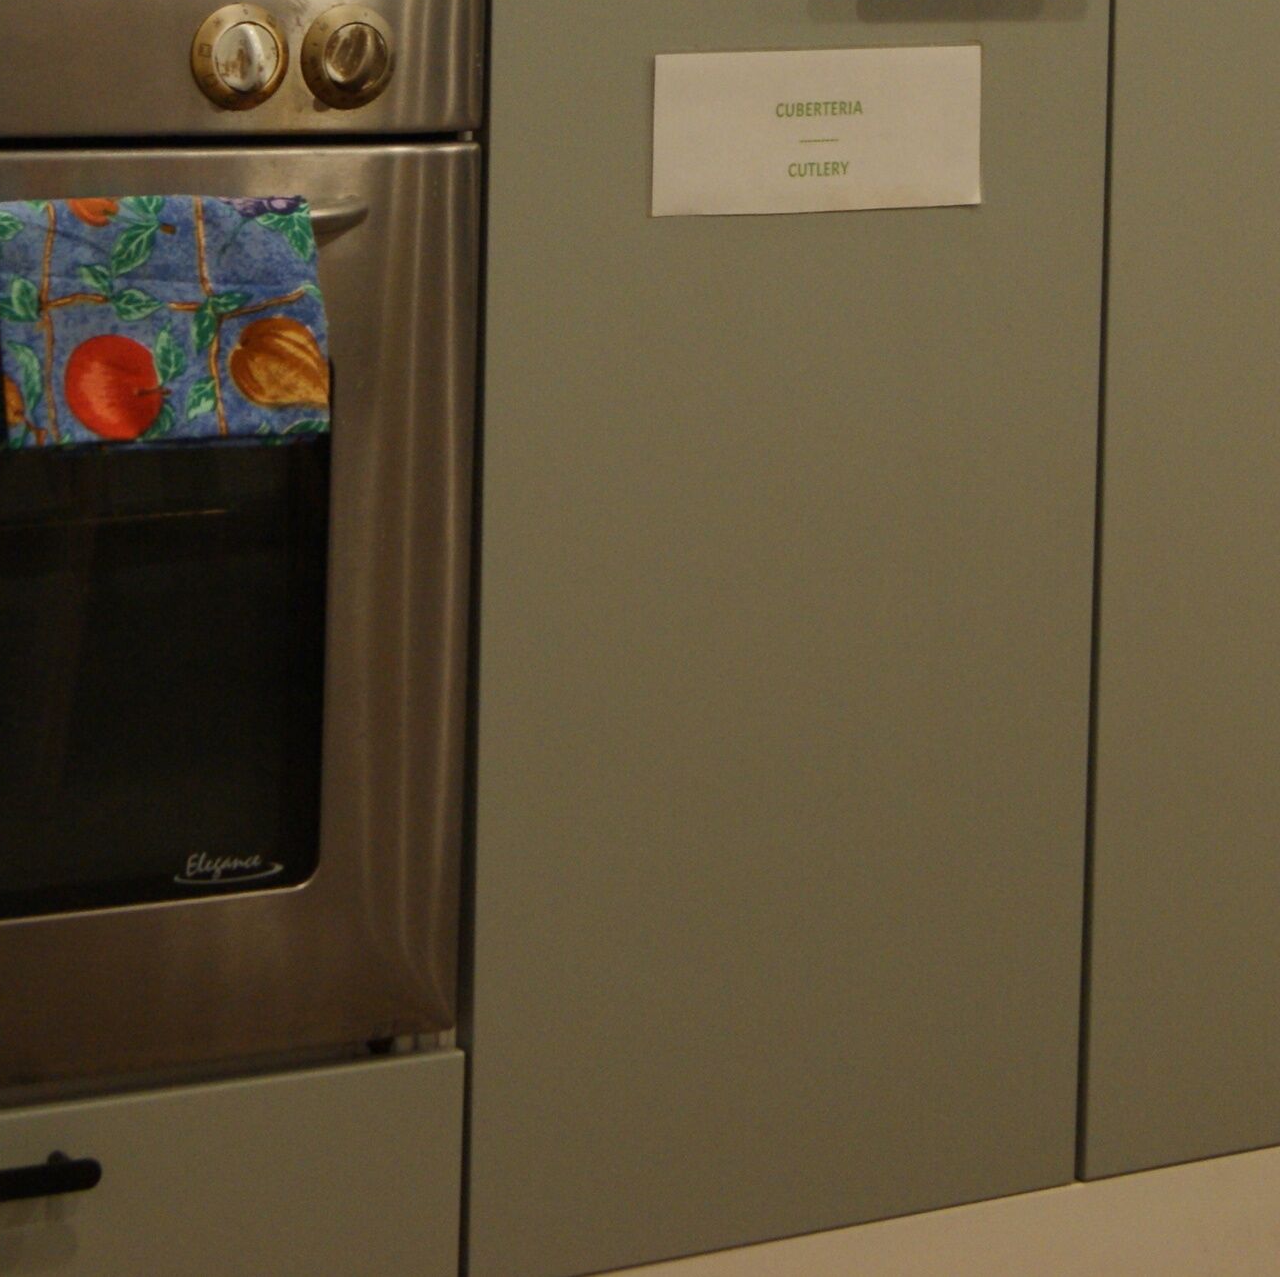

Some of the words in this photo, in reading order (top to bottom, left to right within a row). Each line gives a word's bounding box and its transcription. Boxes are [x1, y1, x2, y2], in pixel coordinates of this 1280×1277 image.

[775, 100, 863, 118] CUBERTERIA
[788, 161, 850, 178] CUTLERY
[186, 851, 263, 880] Elegance
